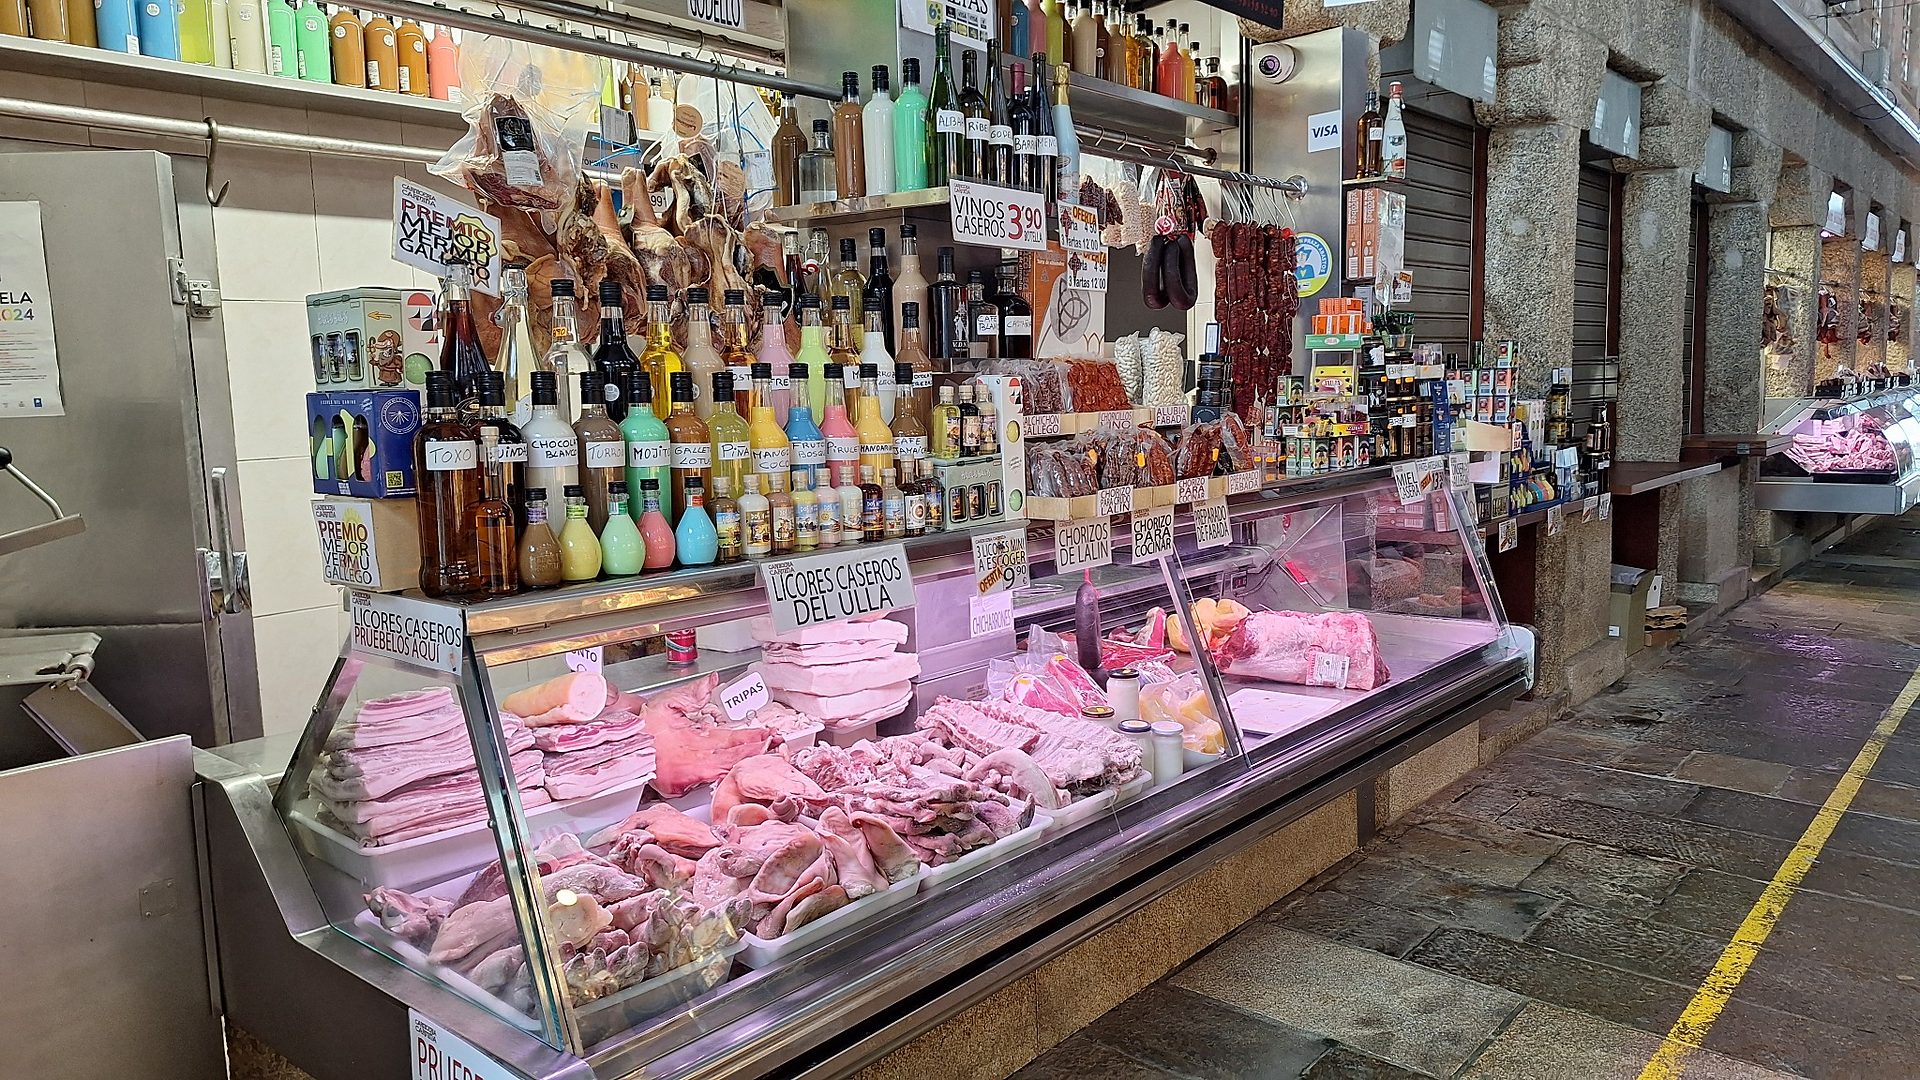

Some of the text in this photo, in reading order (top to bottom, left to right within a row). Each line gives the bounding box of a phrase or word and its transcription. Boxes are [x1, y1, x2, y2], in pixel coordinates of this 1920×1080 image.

[1312, 124, 1339, 139] VISA
[954, 195, 1005, 219] VINOS
[402, 198, 491, 244] PREMIO
[955, 215, 1006, 239] CASEROS
[400, 222, 490, 267] VERMU
[402, 211, 491, 258] MEJOR
[399, 237, 491, 281] GALLO
[0, 308, 35, 321] 024
[1156, 413, 1187, 425] FABADA
[1157, 406, 1186, 416] ALUBIA
[430, 448, 471, 464] TOXO
[1178, 478, 1205, 488] CHORIZO
[1230, 480, 1259, 493] FABADA
[1396, 471, 1417, 487] MIEL
[1101, 487, 1131, 499] CHORIZO
[1179, 486, 1205, 495] PARA
[1101, 503, 1130, 516] LALIN
[1194, 505, 1227, 526] PREPARADO
[318, 521, 368, 542] PREMIO
[1133, 513, 1172, 534] CHORIZO
[1204, 521, 1230, 541] FABADA
[1058, 522, 1109, 548] CHORIZOS
[1134, 526, 1172, 546] PARA
[322, 538, 370, 557] MEJOR
[976, 537, 1026, 559] 3 LICORES MINI
[1060, 540, 1109, 567] DE LALIN
[1134, 538, 1172, 558] COCINAR
[323, 551, 370, 571] VERMU
[979, 550, 1026, 573] A ESCOGER
[324, 564, 373, 585] GALLEGO
[771, 557, 902, 602] LICORES CASEROS
[980, 566, 1005, 593] OFERTA
[793, 584, 894, 626] DEL ULLA
[353, 606, 462, 648] LICORES CASEROS
[354, 625, 441, 664] PRUEBELOS AQUÍ
[724, 681, 764, 710] TRIPAS
[417, 1036, 484, 1080] PRU
